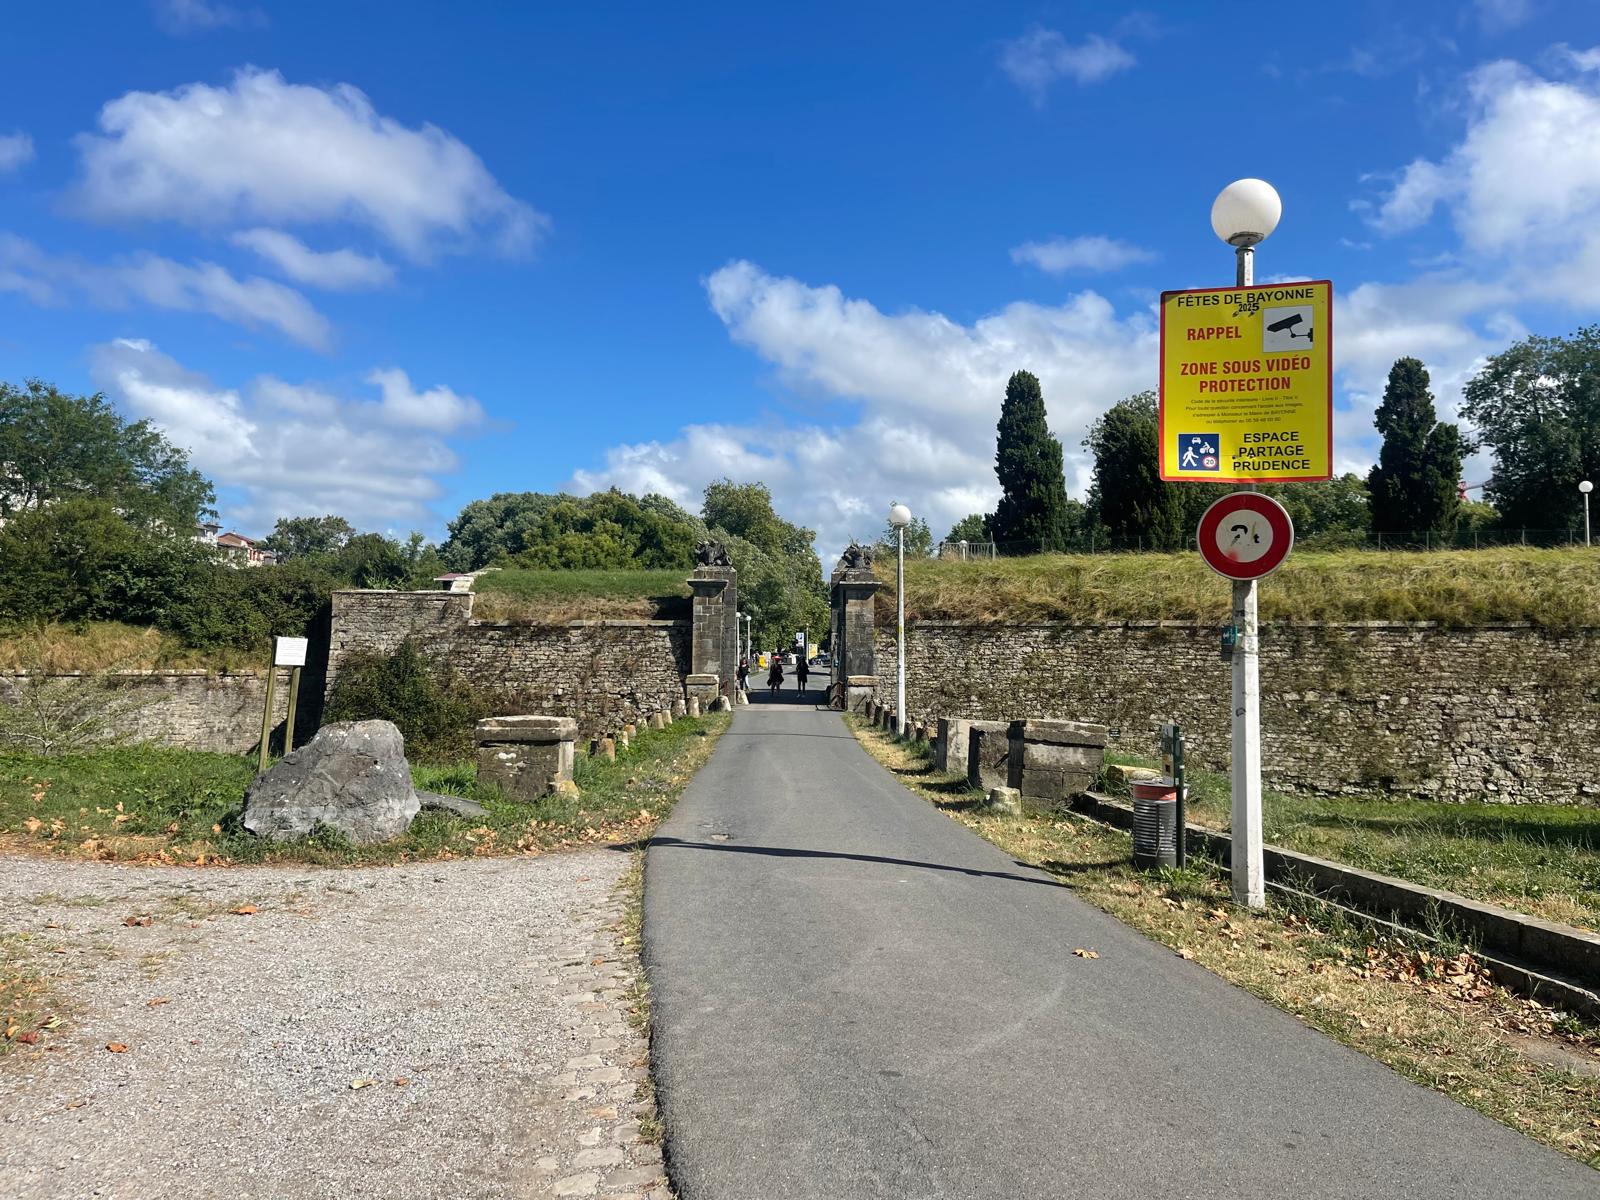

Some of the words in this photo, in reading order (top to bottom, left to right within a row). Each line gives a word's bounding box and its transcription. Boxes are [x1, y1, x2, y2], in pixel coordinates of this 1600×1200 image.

[1177, 294, 1220, 307] FÊTES
[1224, 293, 1243, 305] DE
[1246, 288, 1314, 303] BAYONNE
[1238, 302, 1260, 313] 2025
[1187, 326, 1242, 341] RAPPEL
[1180, 362, 1218, 376] ZONE
[1222, 360, 1261, 374] SOUS
[1266, 354, 1311, 372] VIDÉO
[1199, 377, 1291, 393] PROTECTION
[1243, 431, 1299, 443] ESPACE
[1238, 445, 1305, 458] PARTAGE
[1233, 459, 1311, 471] PRUDENCE
